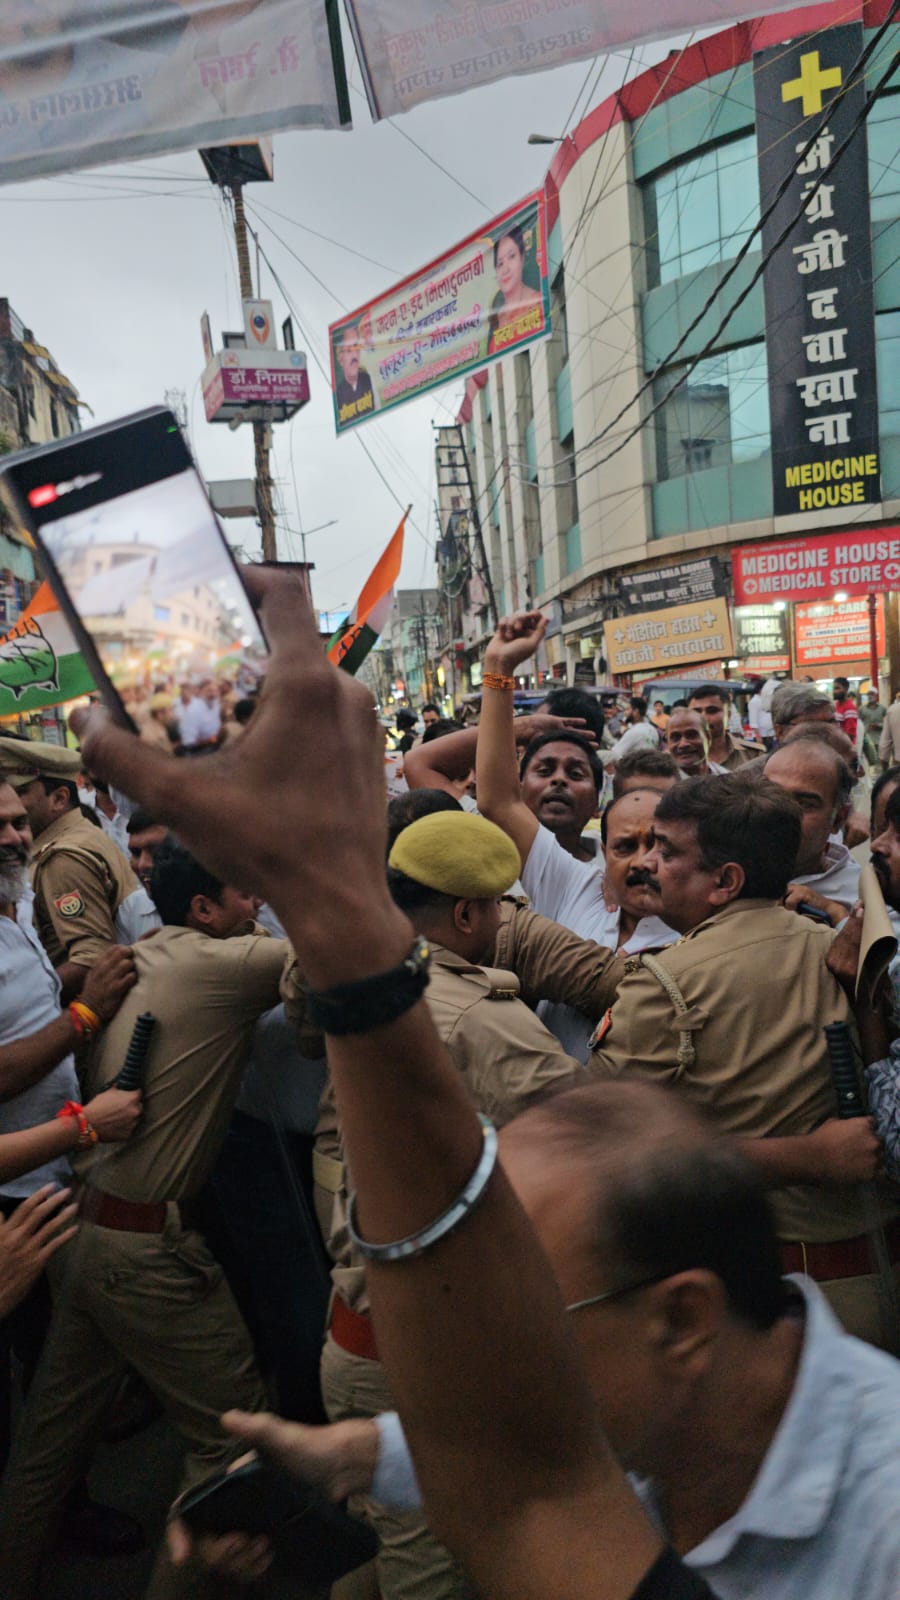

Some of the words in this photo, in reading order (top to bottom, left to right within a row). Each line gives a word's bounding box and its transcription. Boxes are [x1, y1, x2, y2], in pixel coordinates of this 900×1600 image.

[785, 453, 877, 488] MEDICINE
[799, 481, 865, 510] HOUSE
[741, 547, 829, 577] MEDICINE
[835, 540, 900, 565] HOUSE
[759, 570, 826, 594] MEDICAL
[830, 564, 882, 587] STORE
